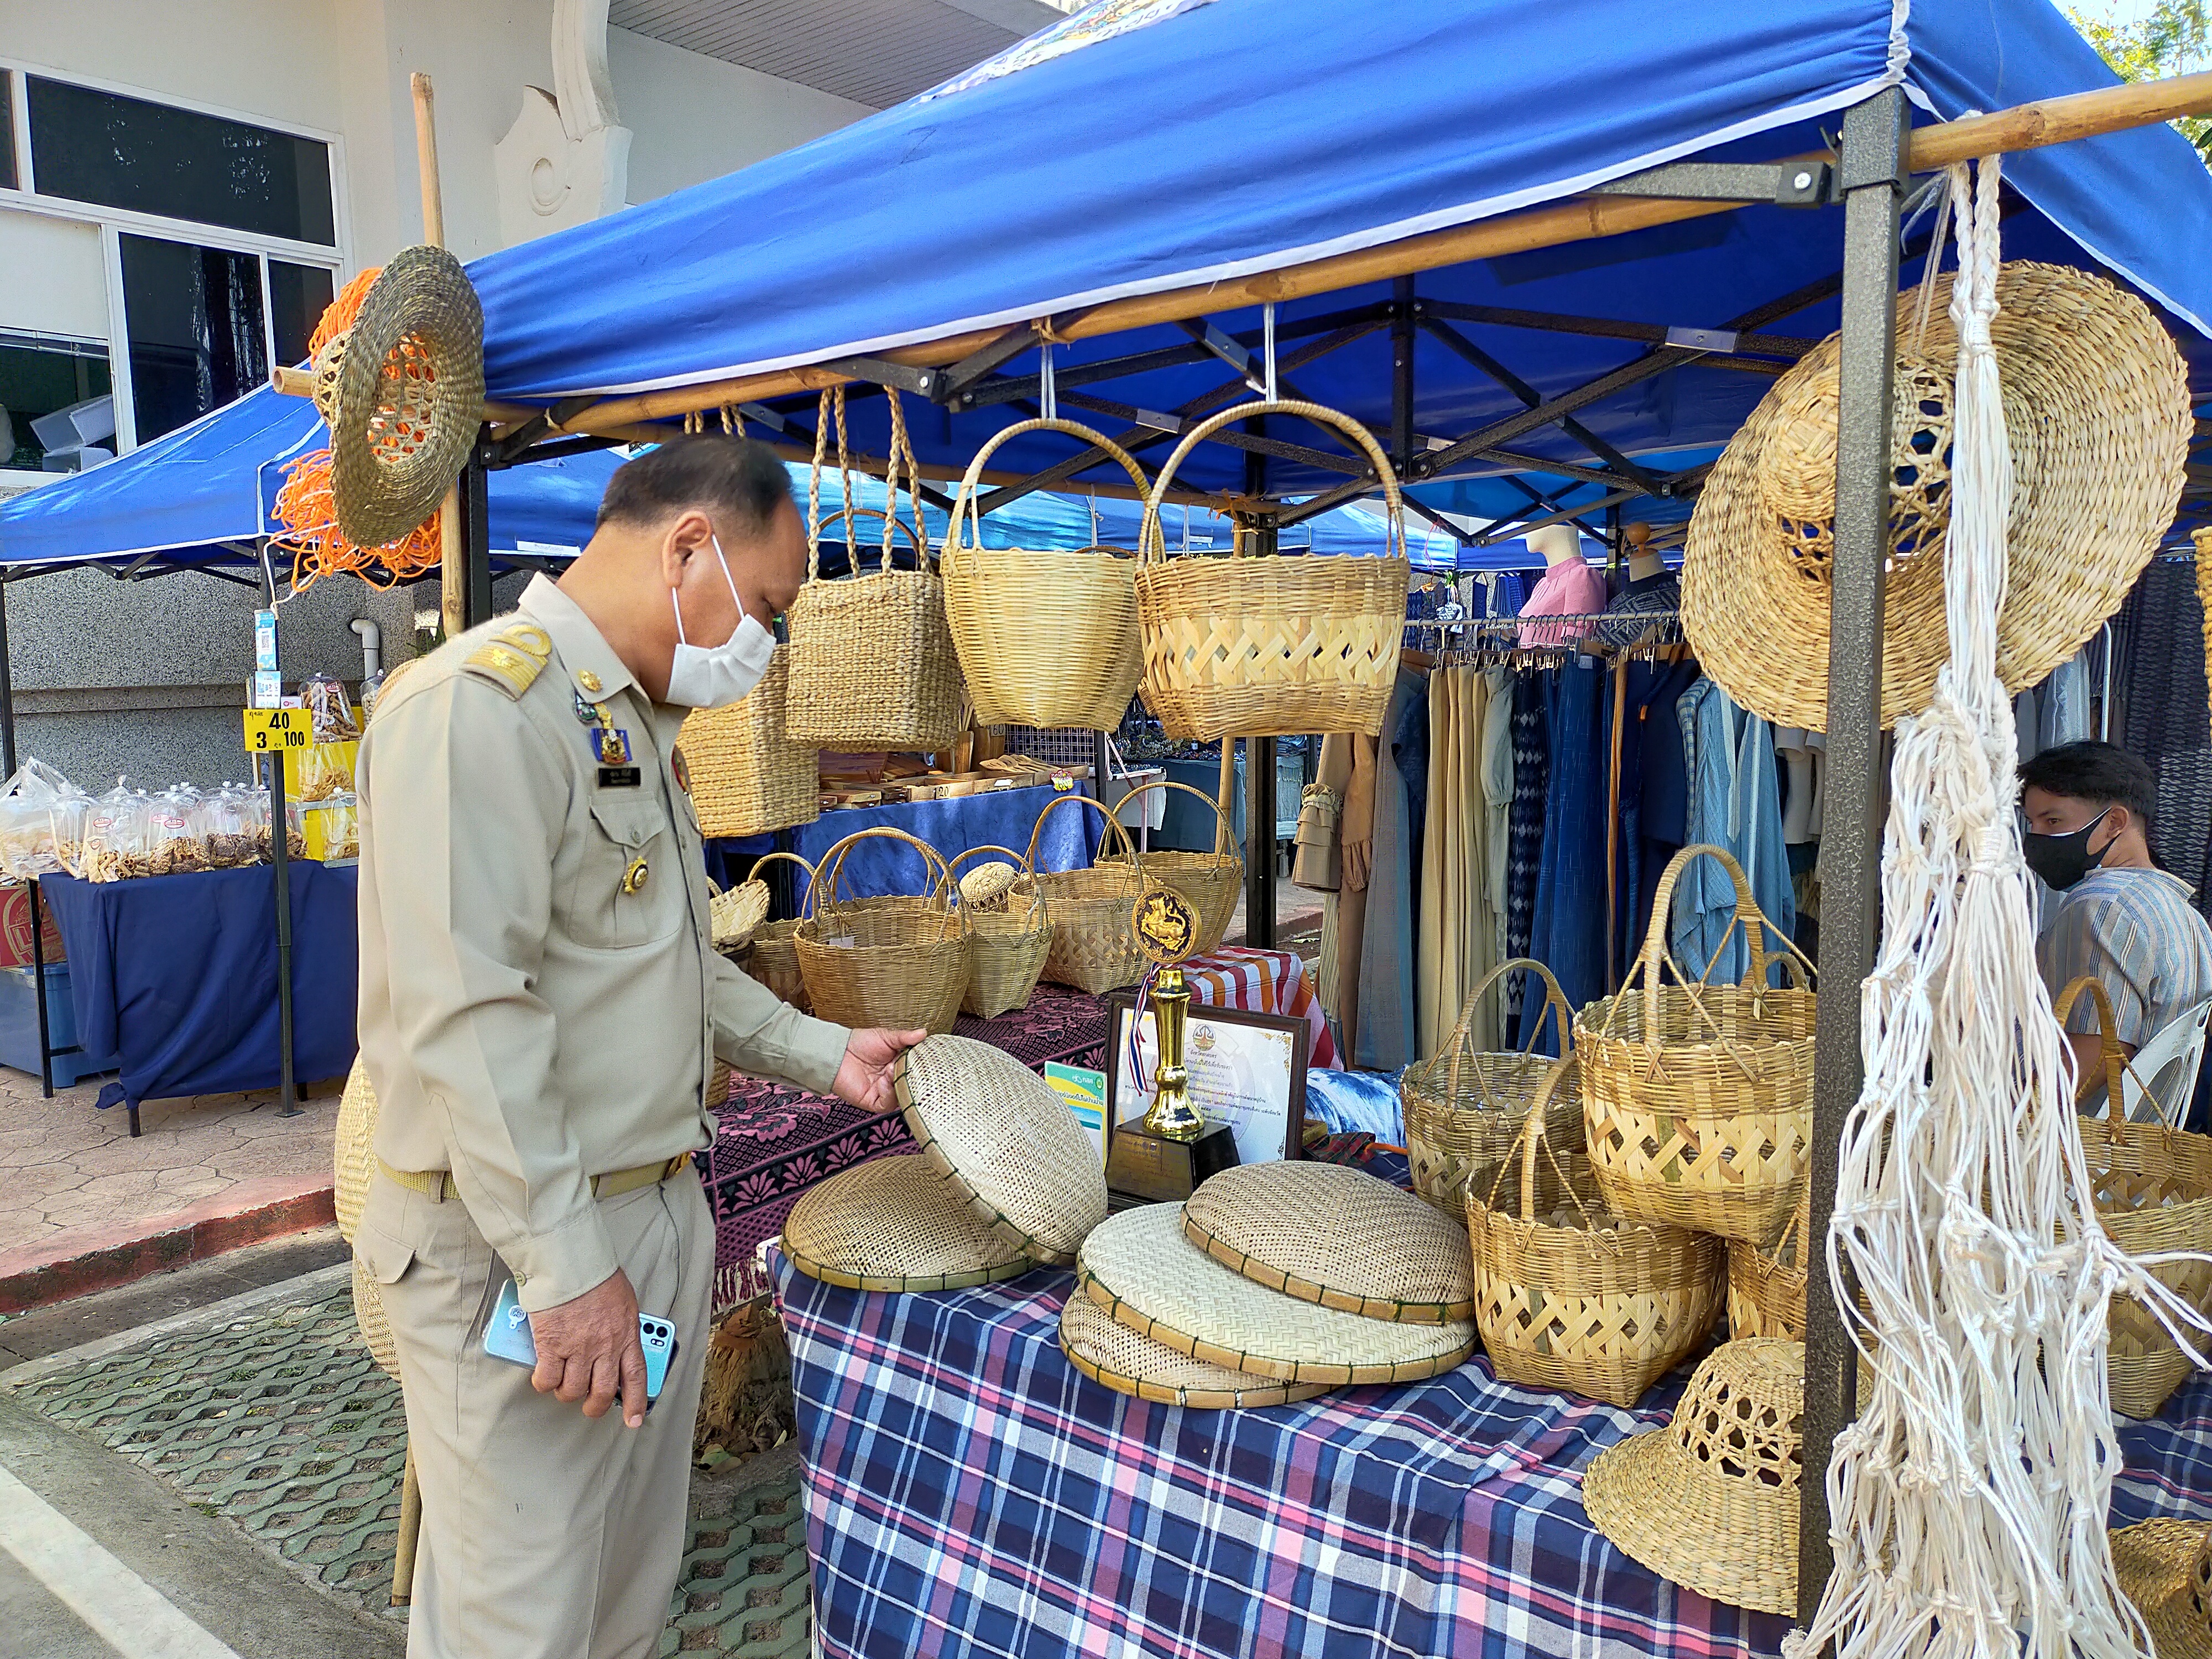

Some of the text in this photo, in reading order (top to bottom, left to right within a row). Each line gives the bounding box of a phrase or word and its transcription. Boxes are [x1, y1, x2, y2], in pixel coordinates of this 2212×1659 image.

[269, 712, 289, 729] 40
[993, 723, 1004, 735] 60
[256, 732, 267, 748] 3
[284, 731, 304, 746] 100
[939, 786, 949, 796] 20
